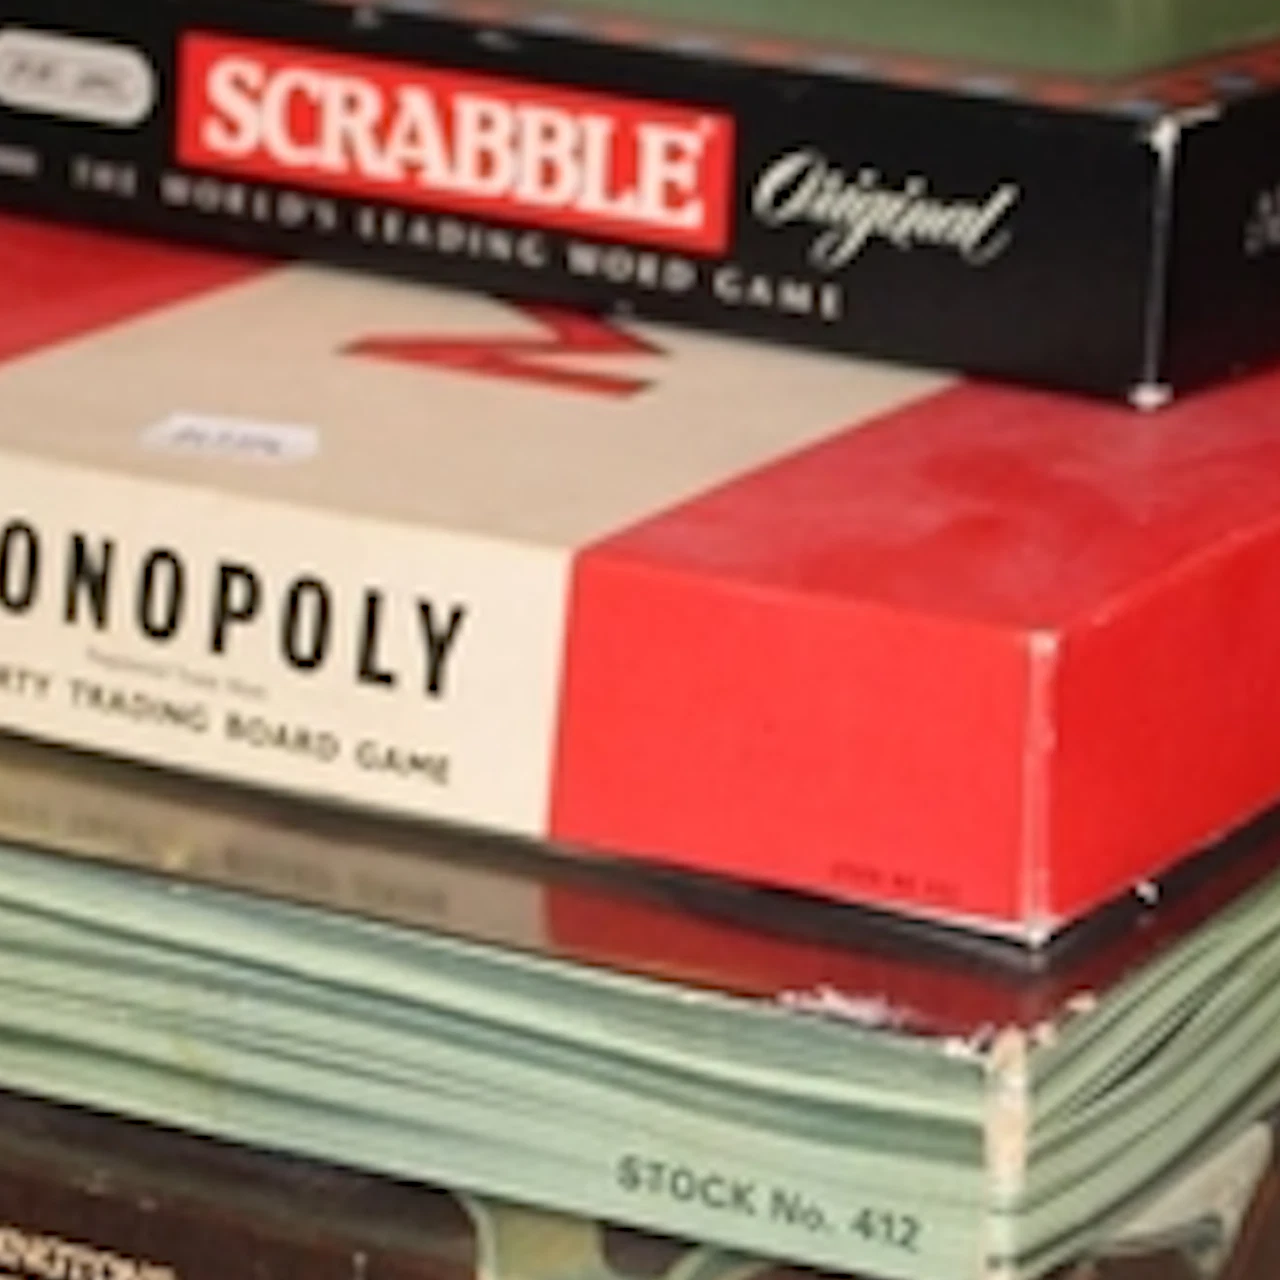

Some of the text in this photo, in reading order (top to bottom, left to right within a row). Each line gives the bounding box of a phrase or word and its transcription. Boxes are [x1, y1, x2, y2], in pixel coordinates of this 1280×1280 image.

[203, 56, 707, 230] SCRABBLE
[72, 154, 136, 197] THE
[160, 173, 338, 231] WORLD'S
[357, 206, 548, 268] LEADING
[566, 239, 698, 292] WORD
[712, 264, 844, 320] GAME
[752, 146, 1020, 268] Original
[70, 681, 209, 734] TRADING
[225, 713, 341, 764] BOARD
[354, 739, 453, 786] GAME
[617, 1153, 923, 1253] STOCK No. 412
